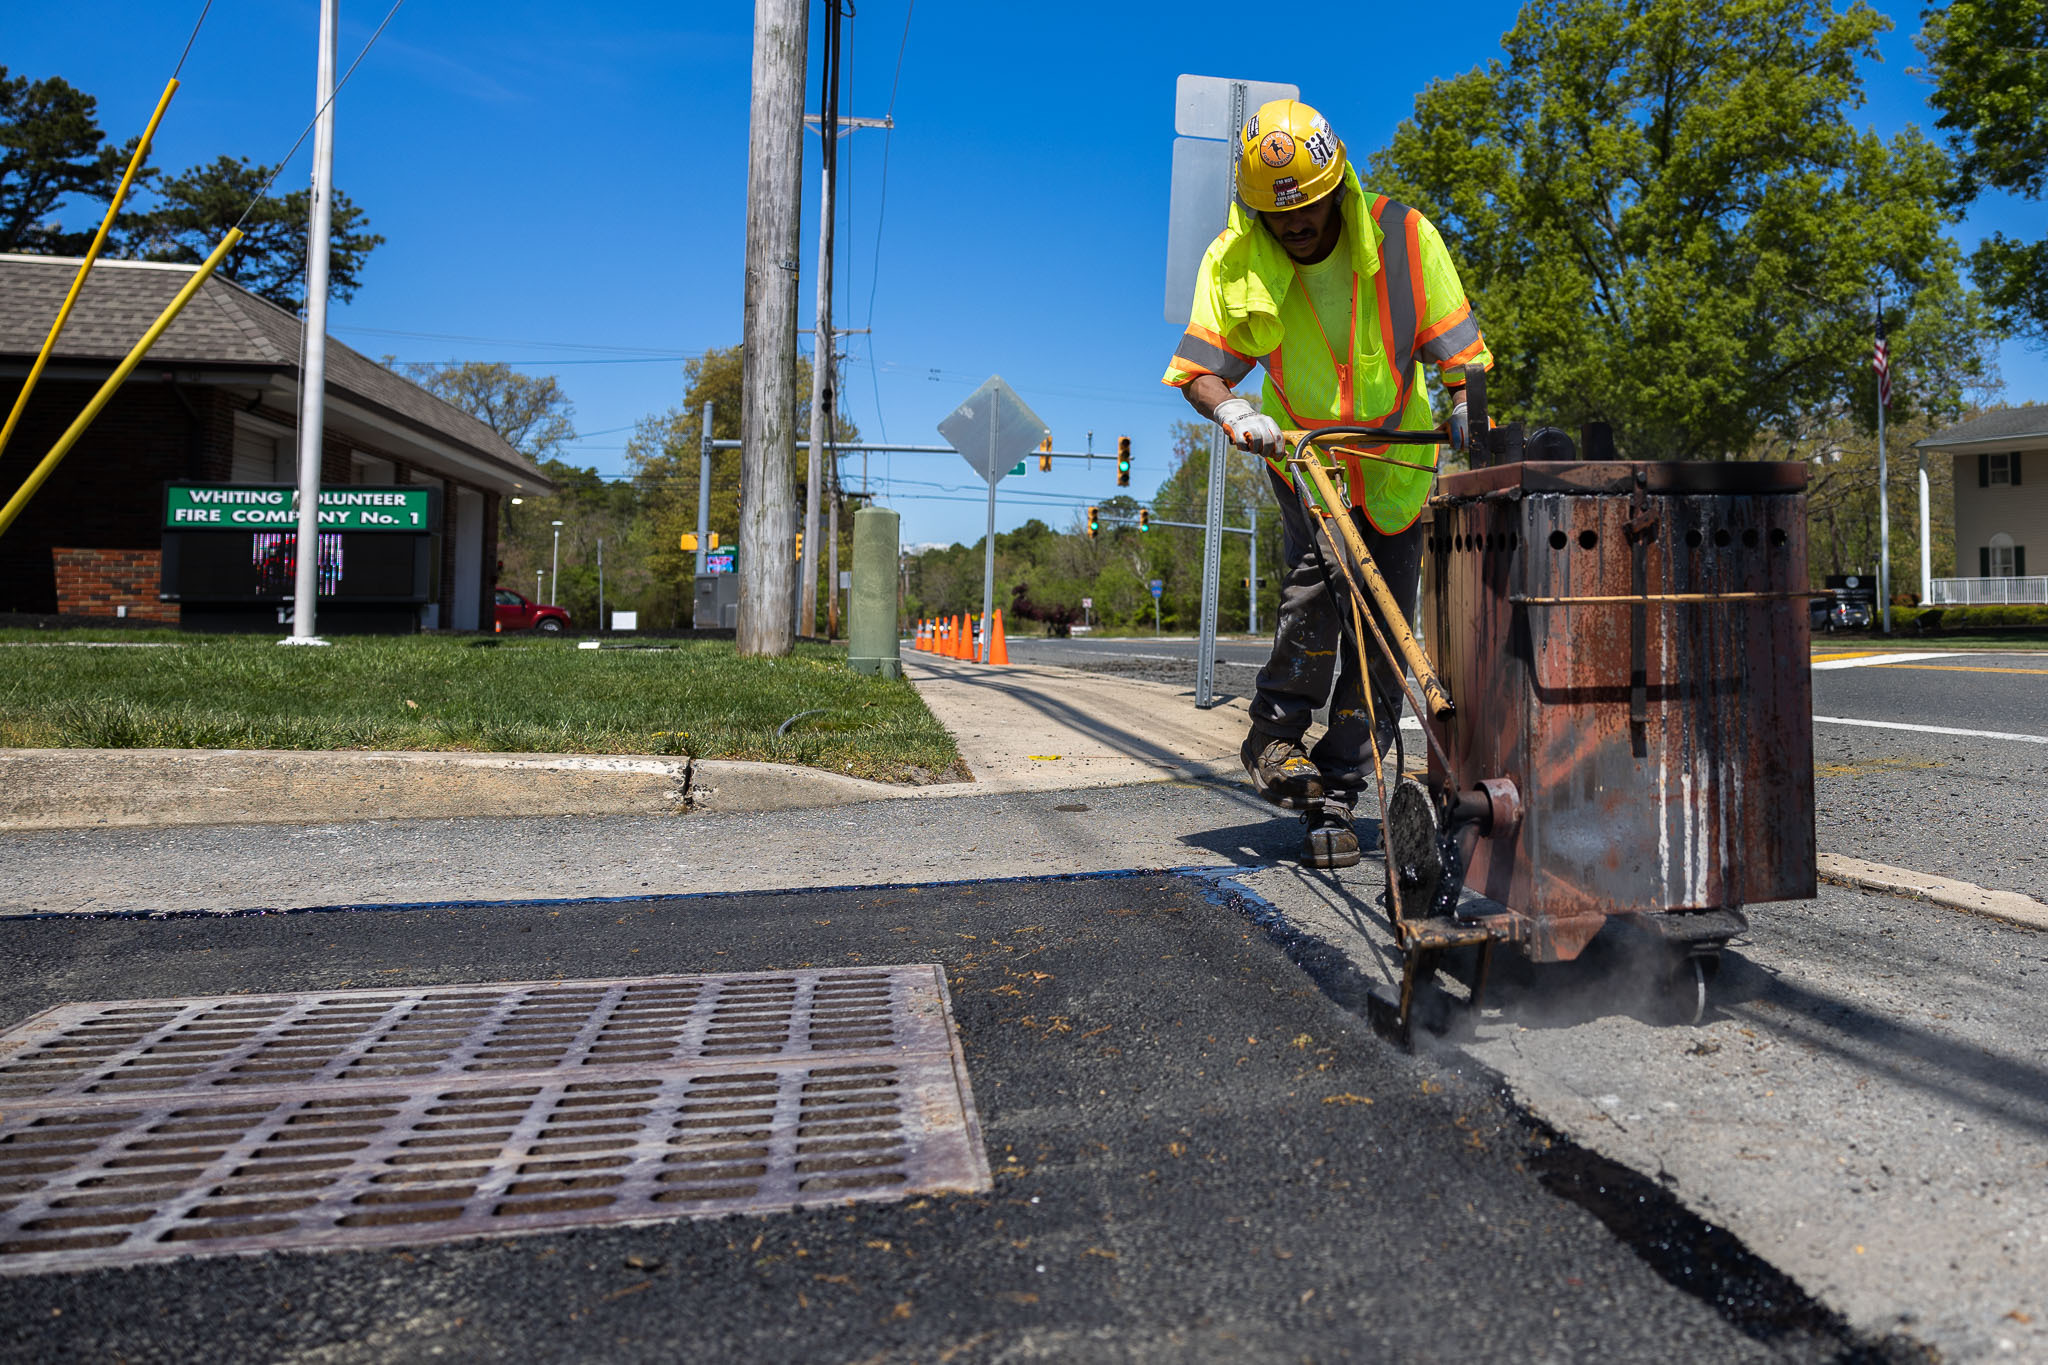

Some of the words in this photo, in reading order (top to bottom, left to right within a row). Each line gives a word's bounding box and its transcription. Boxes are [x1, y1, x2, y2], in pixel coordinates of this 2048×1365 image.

[1262, 134, 1274, 146] WILL
[189, 490, 284, 504] WHITING
[318, 493, 407, 506] LUNTEER
[175, 509, 221, 522] FIRE
[231, 509, 351, 523] COMPNY
[360, 511, 400, 524] No.
[410, 512, 419, 525] 1
